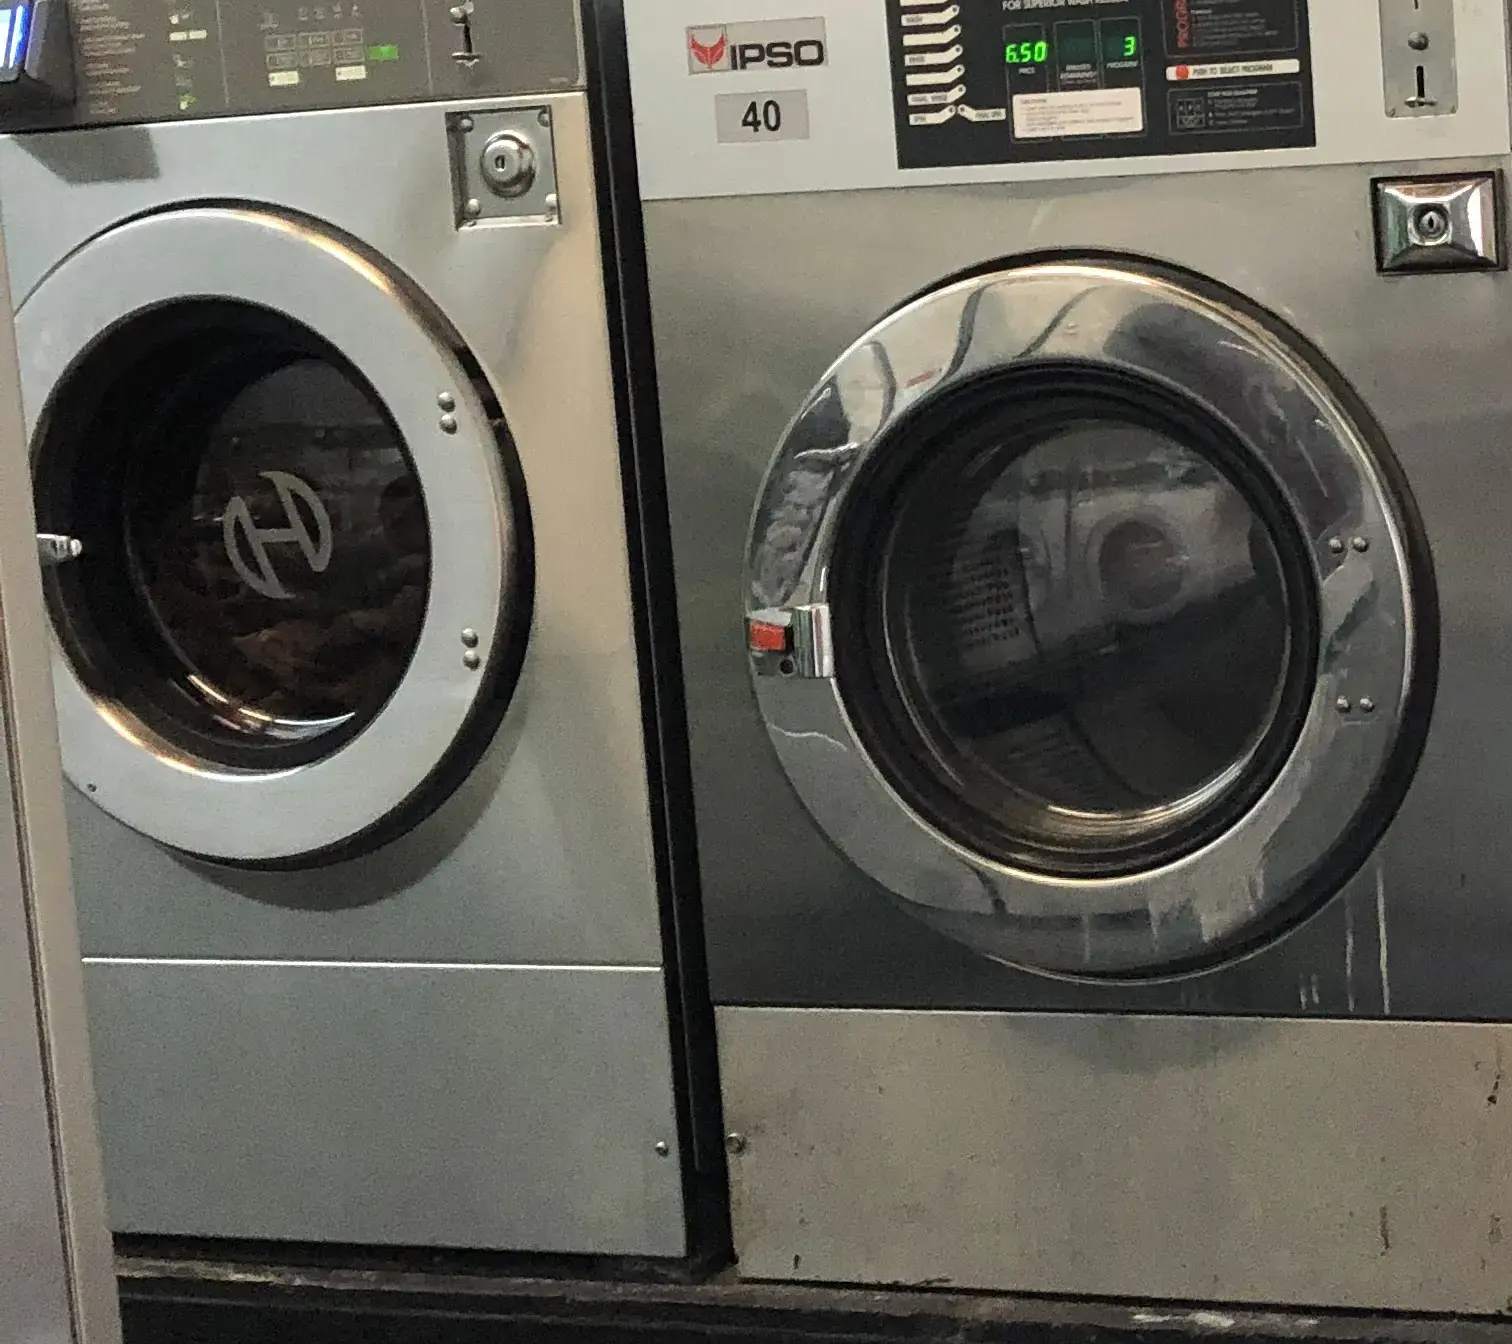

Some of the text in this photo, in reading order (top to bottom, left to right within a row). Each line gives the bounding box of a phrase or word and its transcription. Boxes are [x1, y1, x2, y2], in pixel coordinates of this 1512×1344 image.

[1002, 0, 1021, 11] FOR
[730, 39, 825, 70] IPSO
[1005, 41, 1048, 64] 6.50
[1123, 36, 1136, 56] 3
[741, 99, 781, 133] 40
